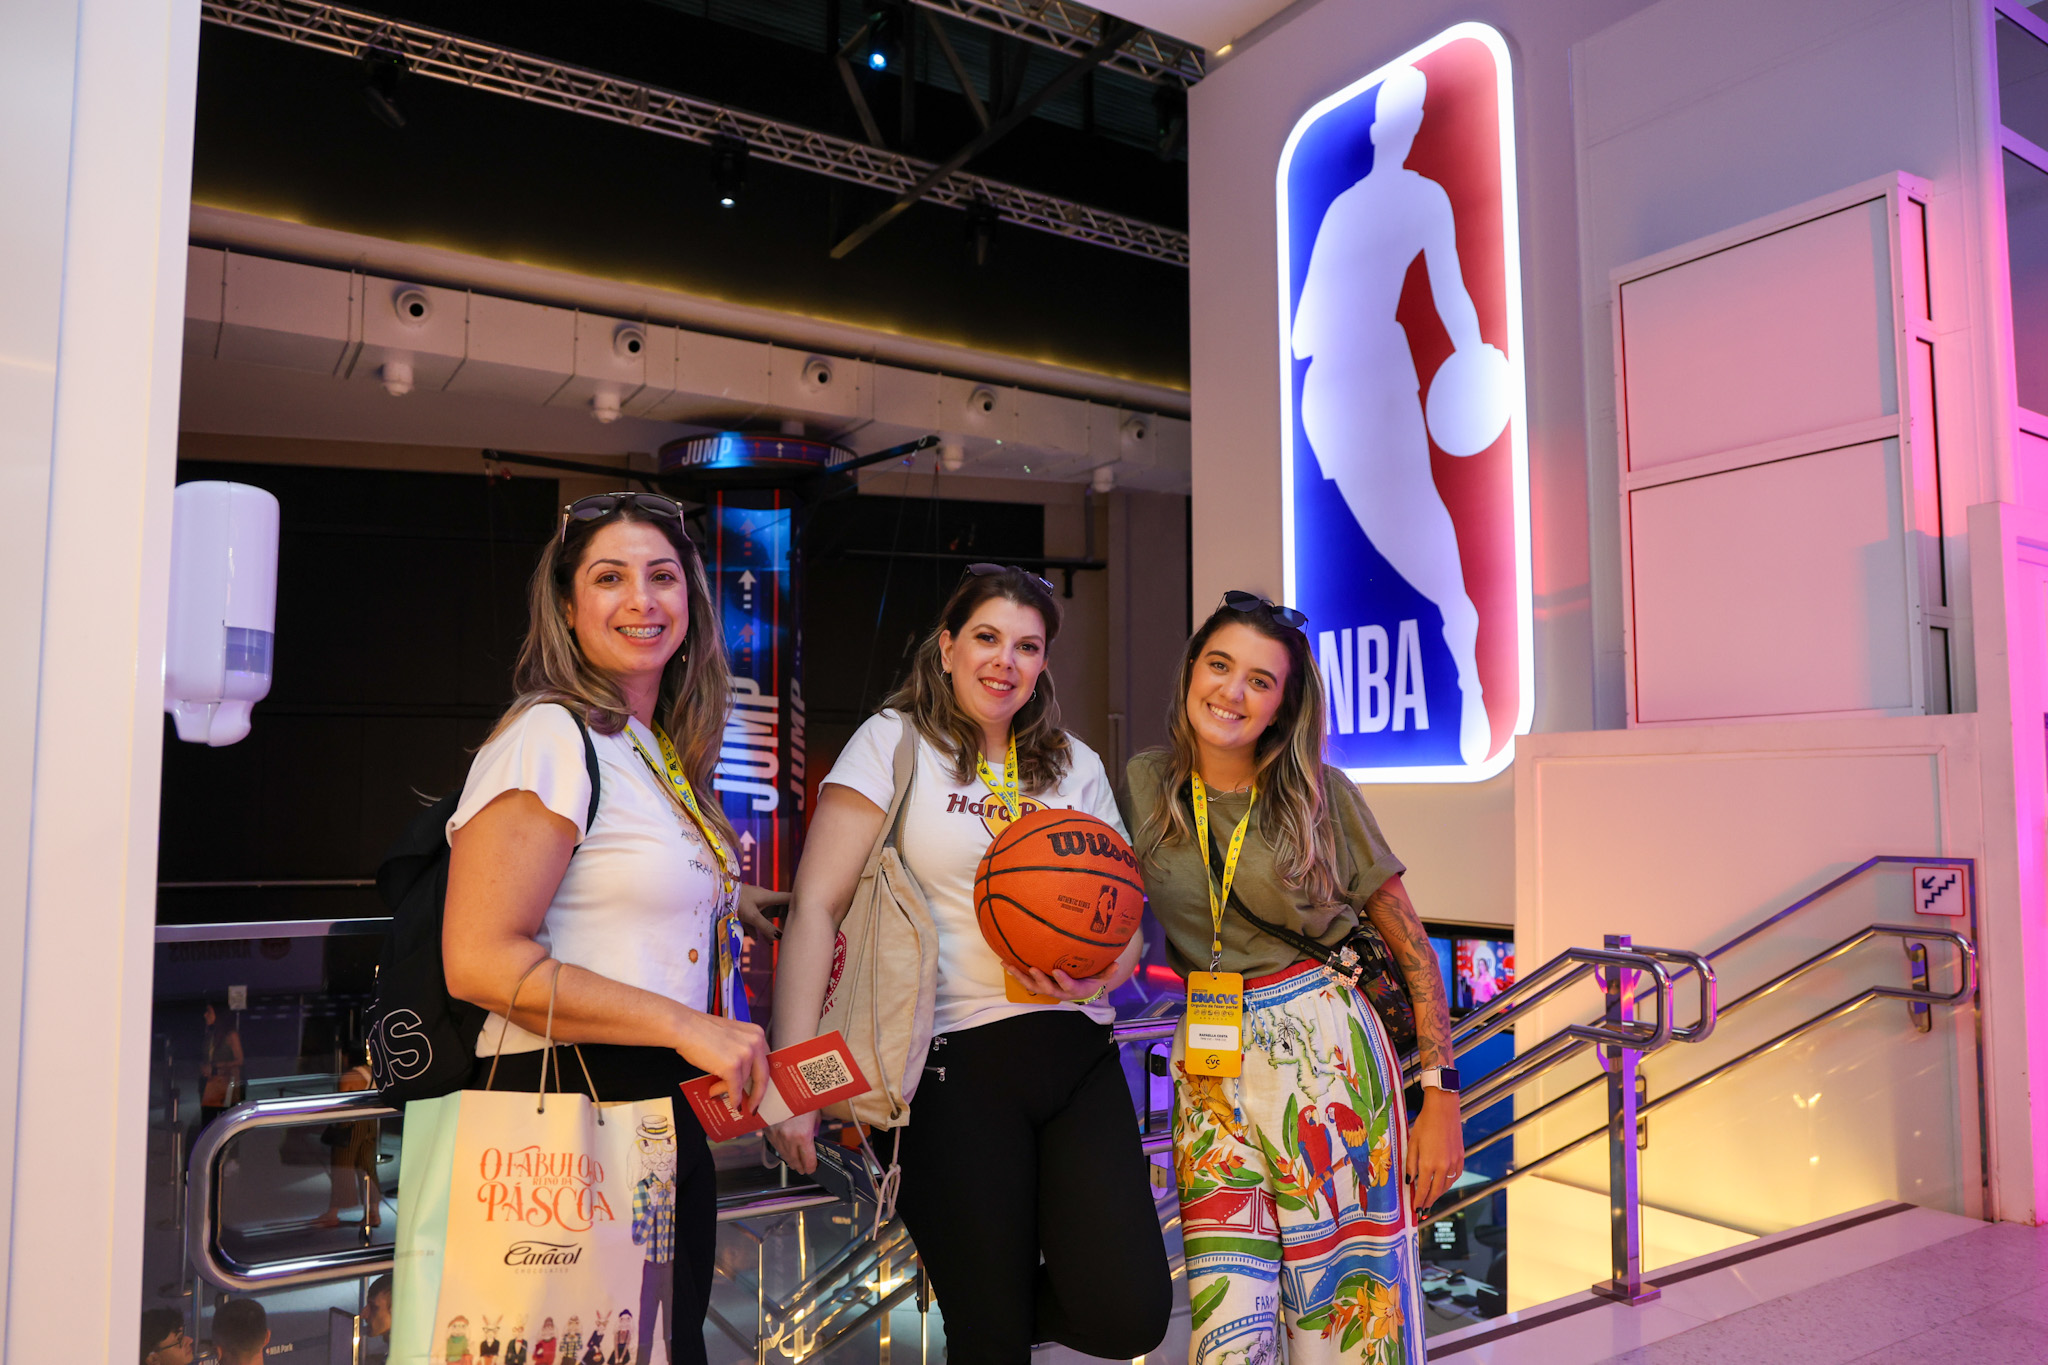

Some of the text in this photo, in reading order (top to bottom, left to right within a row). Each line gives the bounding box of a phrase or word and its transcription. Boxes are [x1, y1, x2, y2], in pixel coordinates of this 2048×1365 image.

[681, 436, 733, 466] JUMP
[1318, 618, 1430, 736] NBA
[712, 676, 780, 813] JUMP
[790, 677, 806, 812] JUMP
[1192, 993, 1238, 1004] DNA CVC
[480, 1147, 503, 1182] O
[532, 1177, 573, 1186] REINO DA
[477, 1181, 616, 1233] PÁSCOA
[503, 1240, 583, 1266] Caracol
